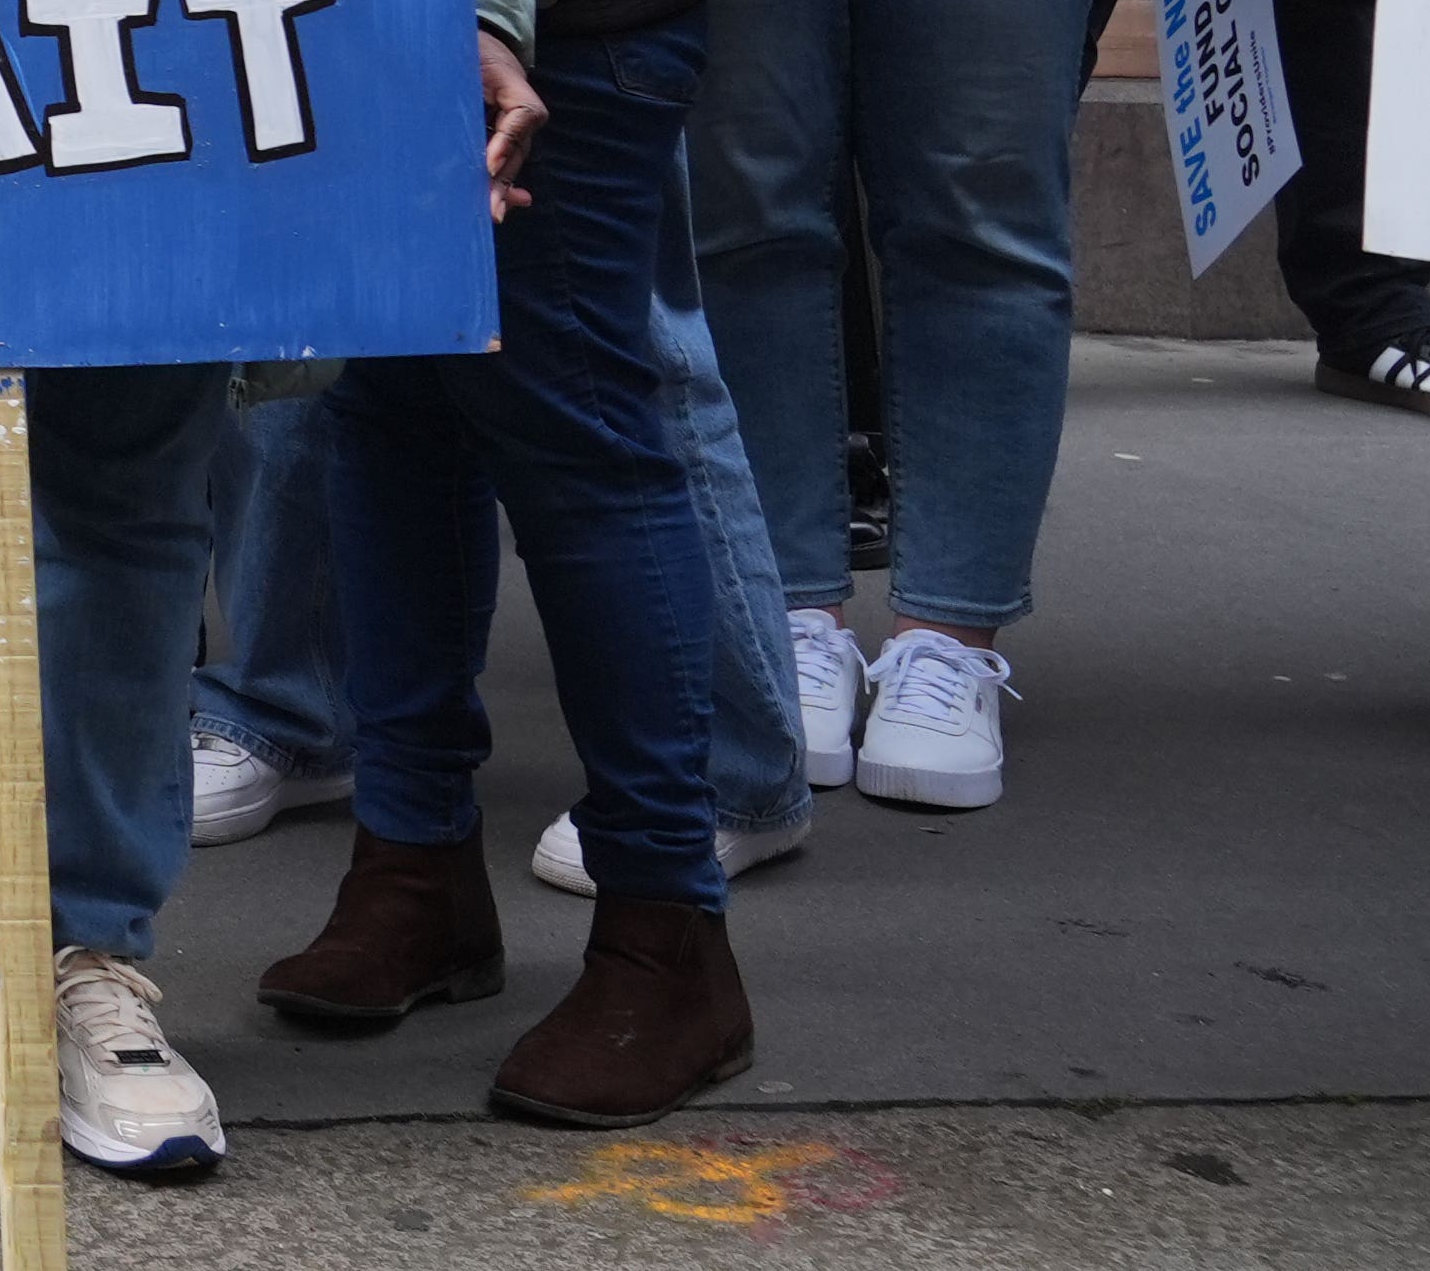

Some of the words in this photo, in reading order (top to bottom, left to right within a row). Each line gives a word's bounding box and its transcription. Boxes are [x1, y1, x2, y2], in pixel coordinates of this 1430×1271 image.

[1172, 41, 1199, 114] the
[1193, 0, 1226, 128] FUND
[1222, 19, 1260, 188] SOCIAL
[1180, 116, 1217, 237] SAVE
